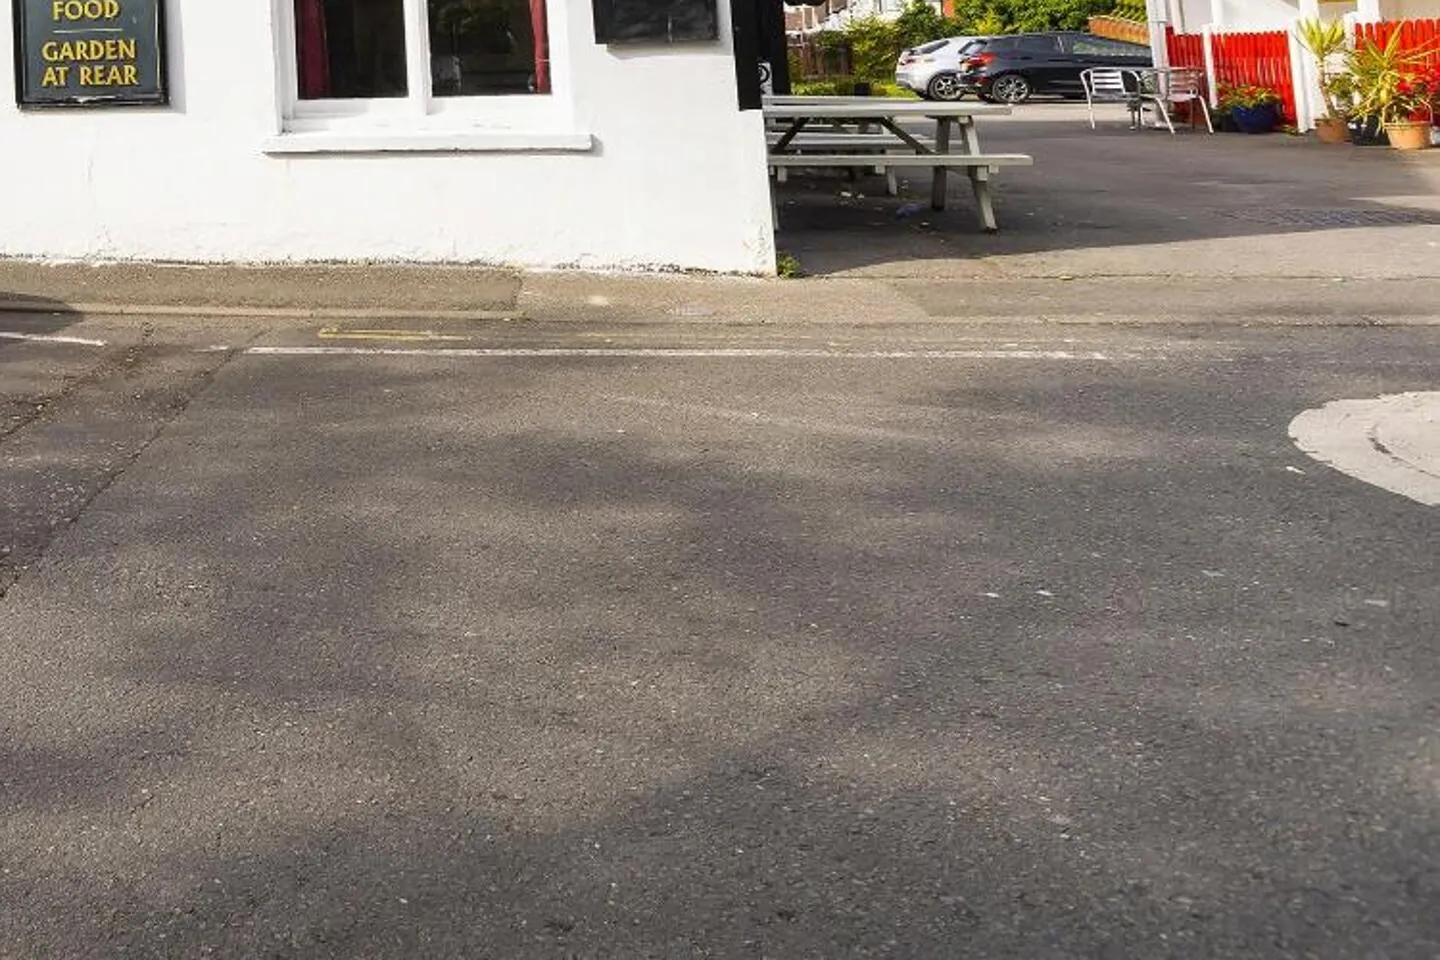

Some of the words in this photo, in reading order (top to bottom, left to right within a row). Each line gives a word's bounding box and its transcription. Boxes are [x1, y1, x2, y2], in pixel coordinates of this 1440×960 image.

[41, 39, 137, 62] GARDEN
[41, 66, 70, 88] AT
[79, 64, 140, 87] REAR
